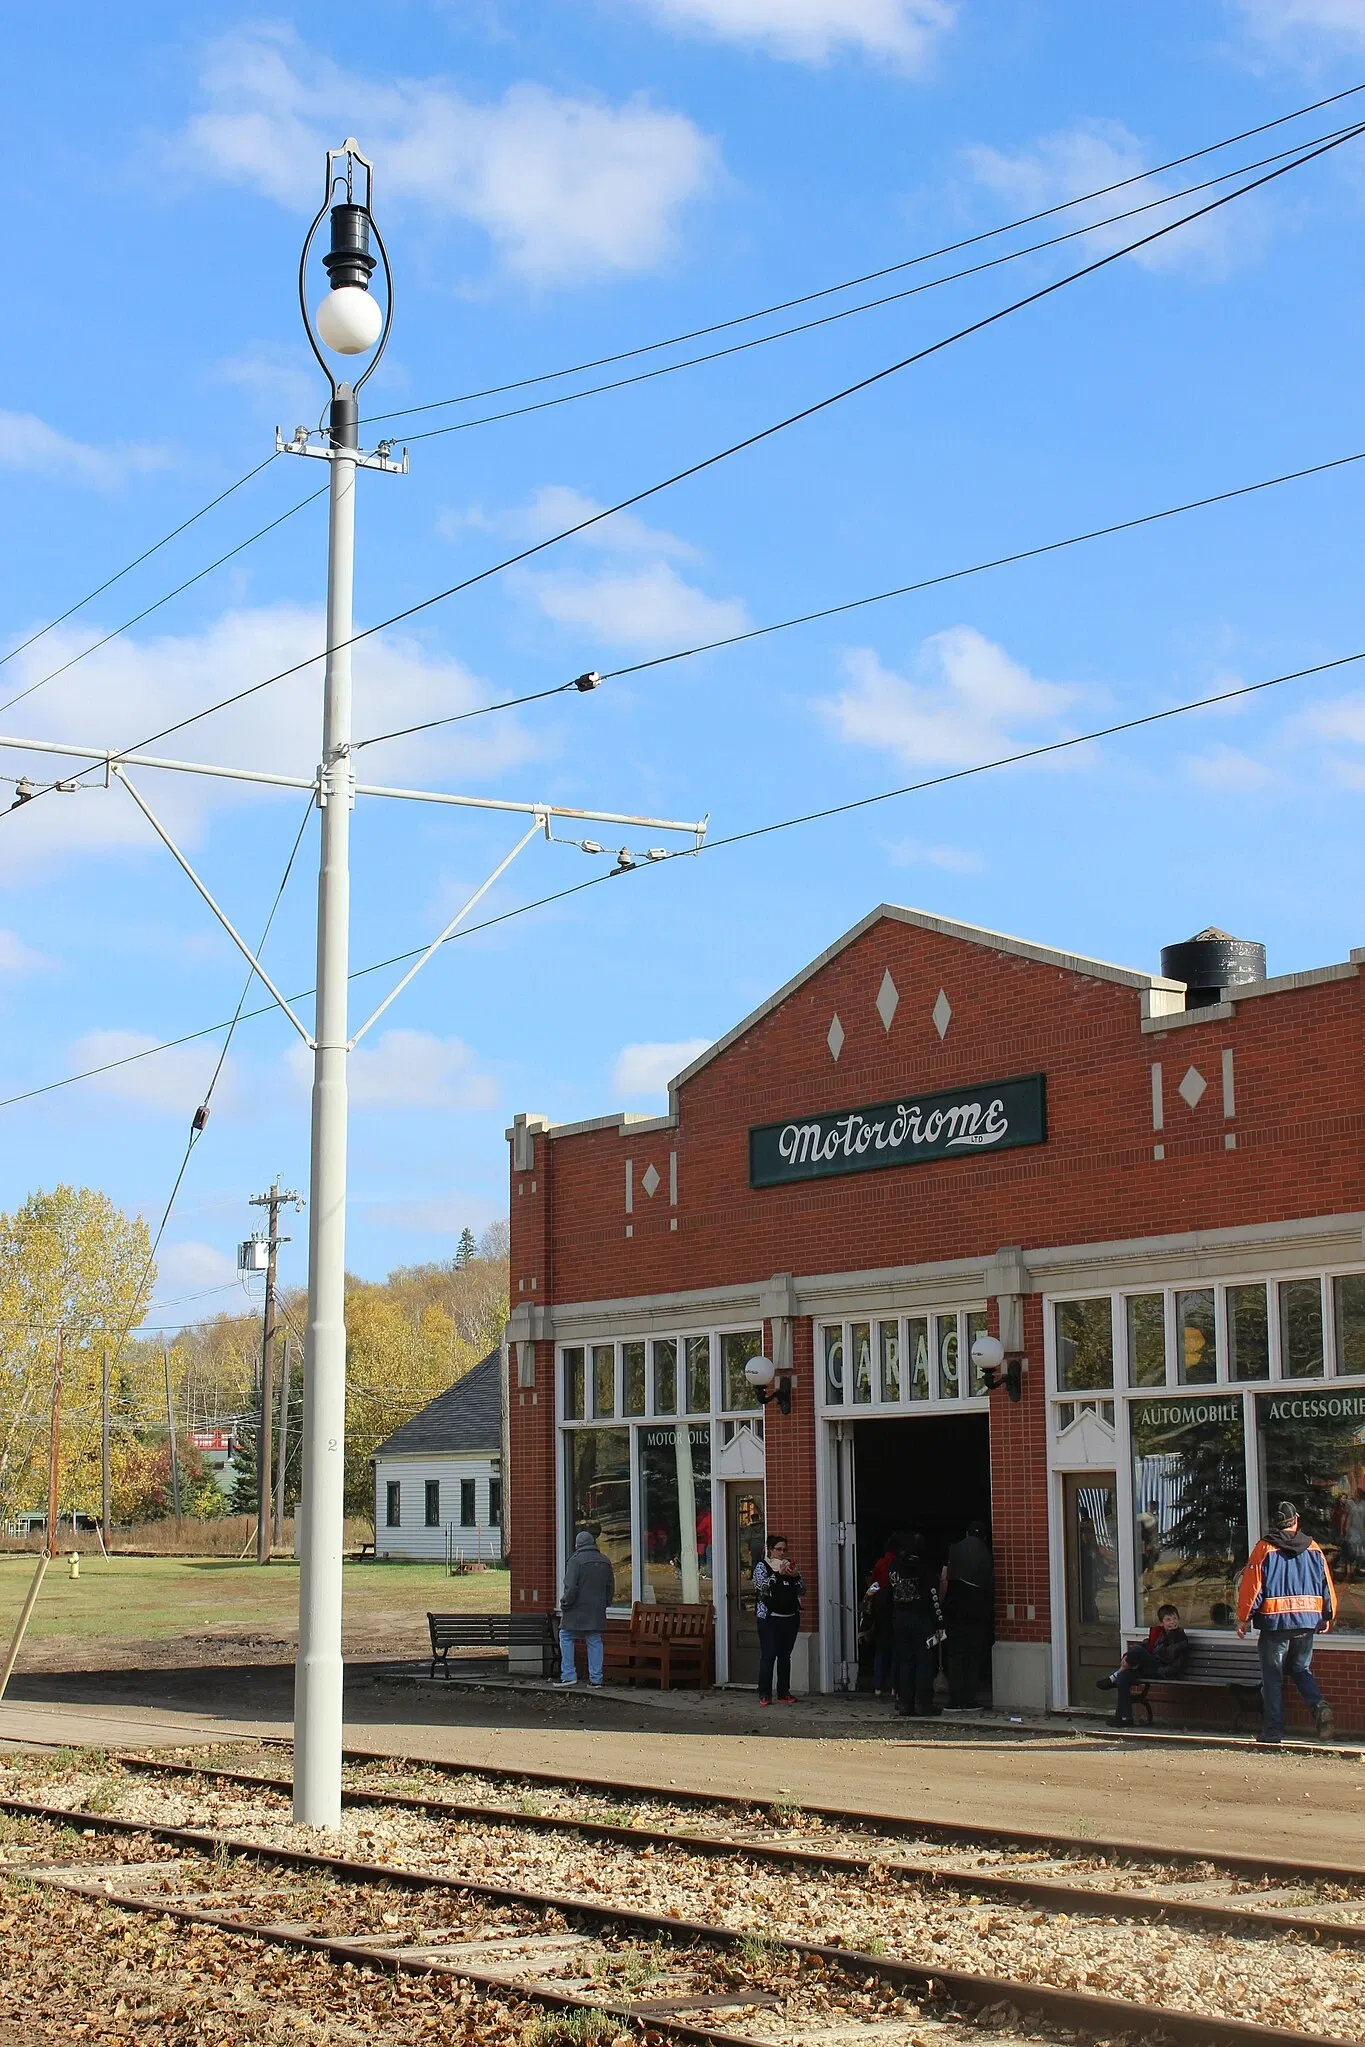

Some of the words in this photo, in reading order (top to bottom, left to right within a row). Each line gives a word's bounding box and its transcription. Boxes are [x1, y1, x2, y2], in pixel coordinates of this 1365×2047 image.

[779, 1099, 1008, 1164] Motordrome
[971, 1135, 983, 1143] LTD
[1141, 1404, 1238, 1425] AUTOMOBILE
[328, 1438, 337, 1451] 2
[647, 1431, 683, 1446] MOTOR
[688, 1430, 709, 1445] OILS
